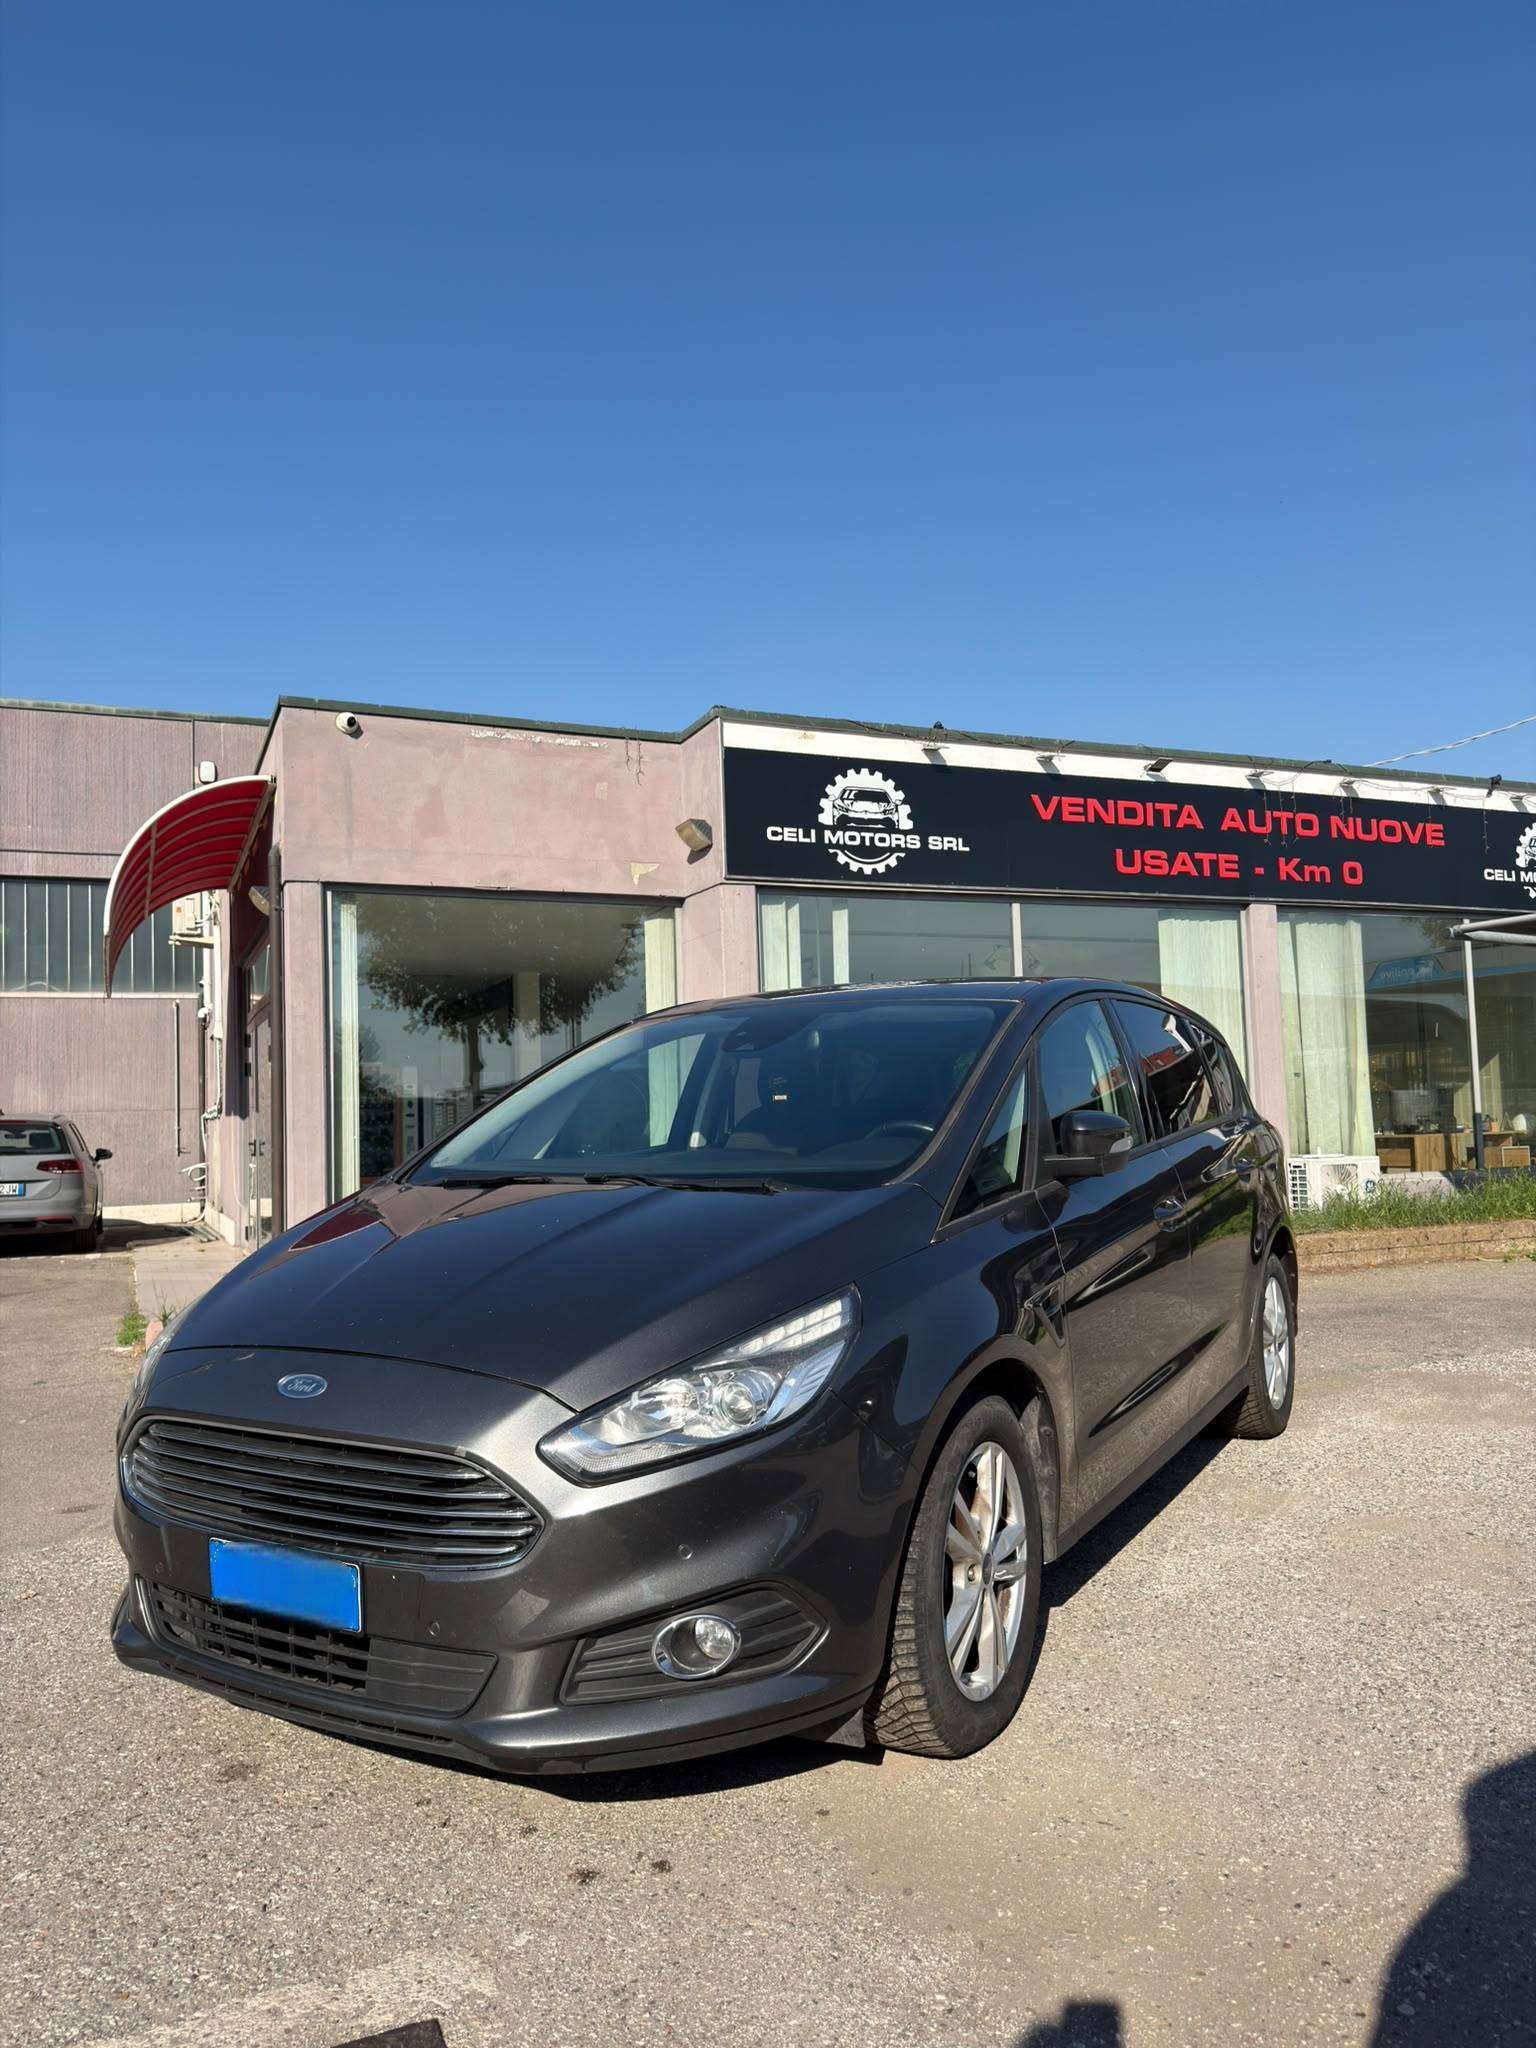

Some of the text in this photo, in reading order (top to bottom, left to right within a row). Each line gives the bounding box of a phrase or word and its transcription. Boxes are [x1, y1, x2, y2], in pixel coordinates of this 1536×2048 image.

[1030, 794, 1446, 847] VENDITA AUTO NUOVE
[766, 826, 970, 851] CELI MOTORS SRL
[1115, 848, 1240, 879] USATE
[1254, 866, 1265, 875] -
[1277, 857, 1331, 884] Km
[1483, 868, 1536, 884] CELI M
[287, 1379, 317, 1393] Ford
